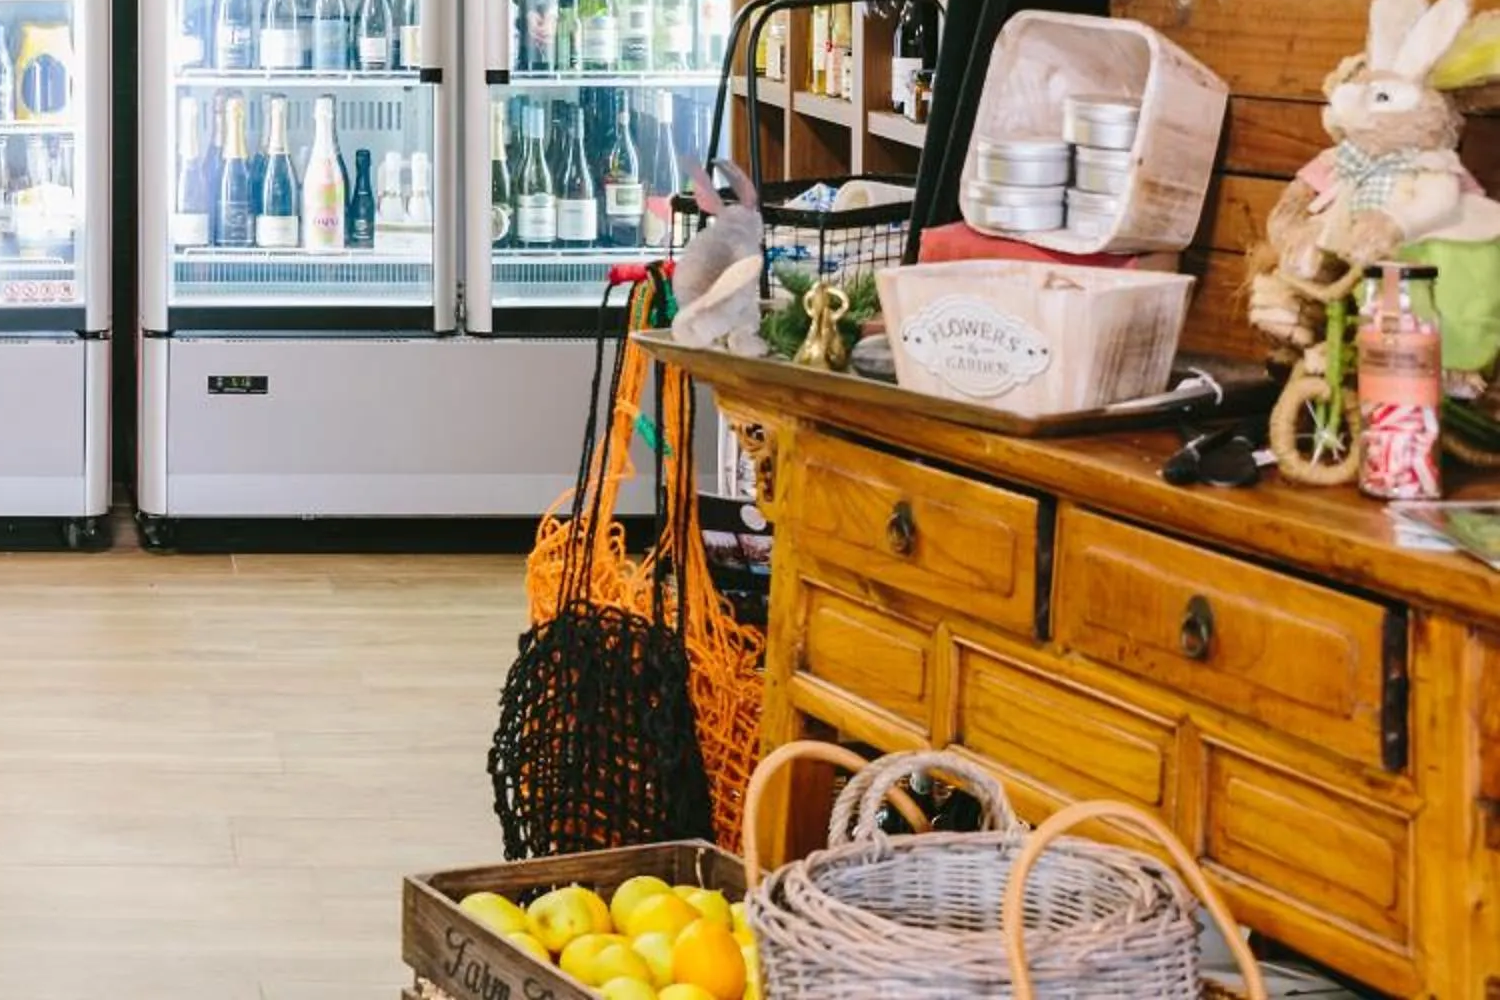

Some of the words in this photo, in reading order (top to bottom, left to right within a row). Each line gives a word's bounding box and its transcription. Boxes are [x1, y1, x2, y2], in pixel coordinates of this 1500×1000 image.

[929, 317, 1021, 351] FLOWERS
[945, 357, 1010, 376] GARDEN
[444, 926, 512, 1000] Farm
